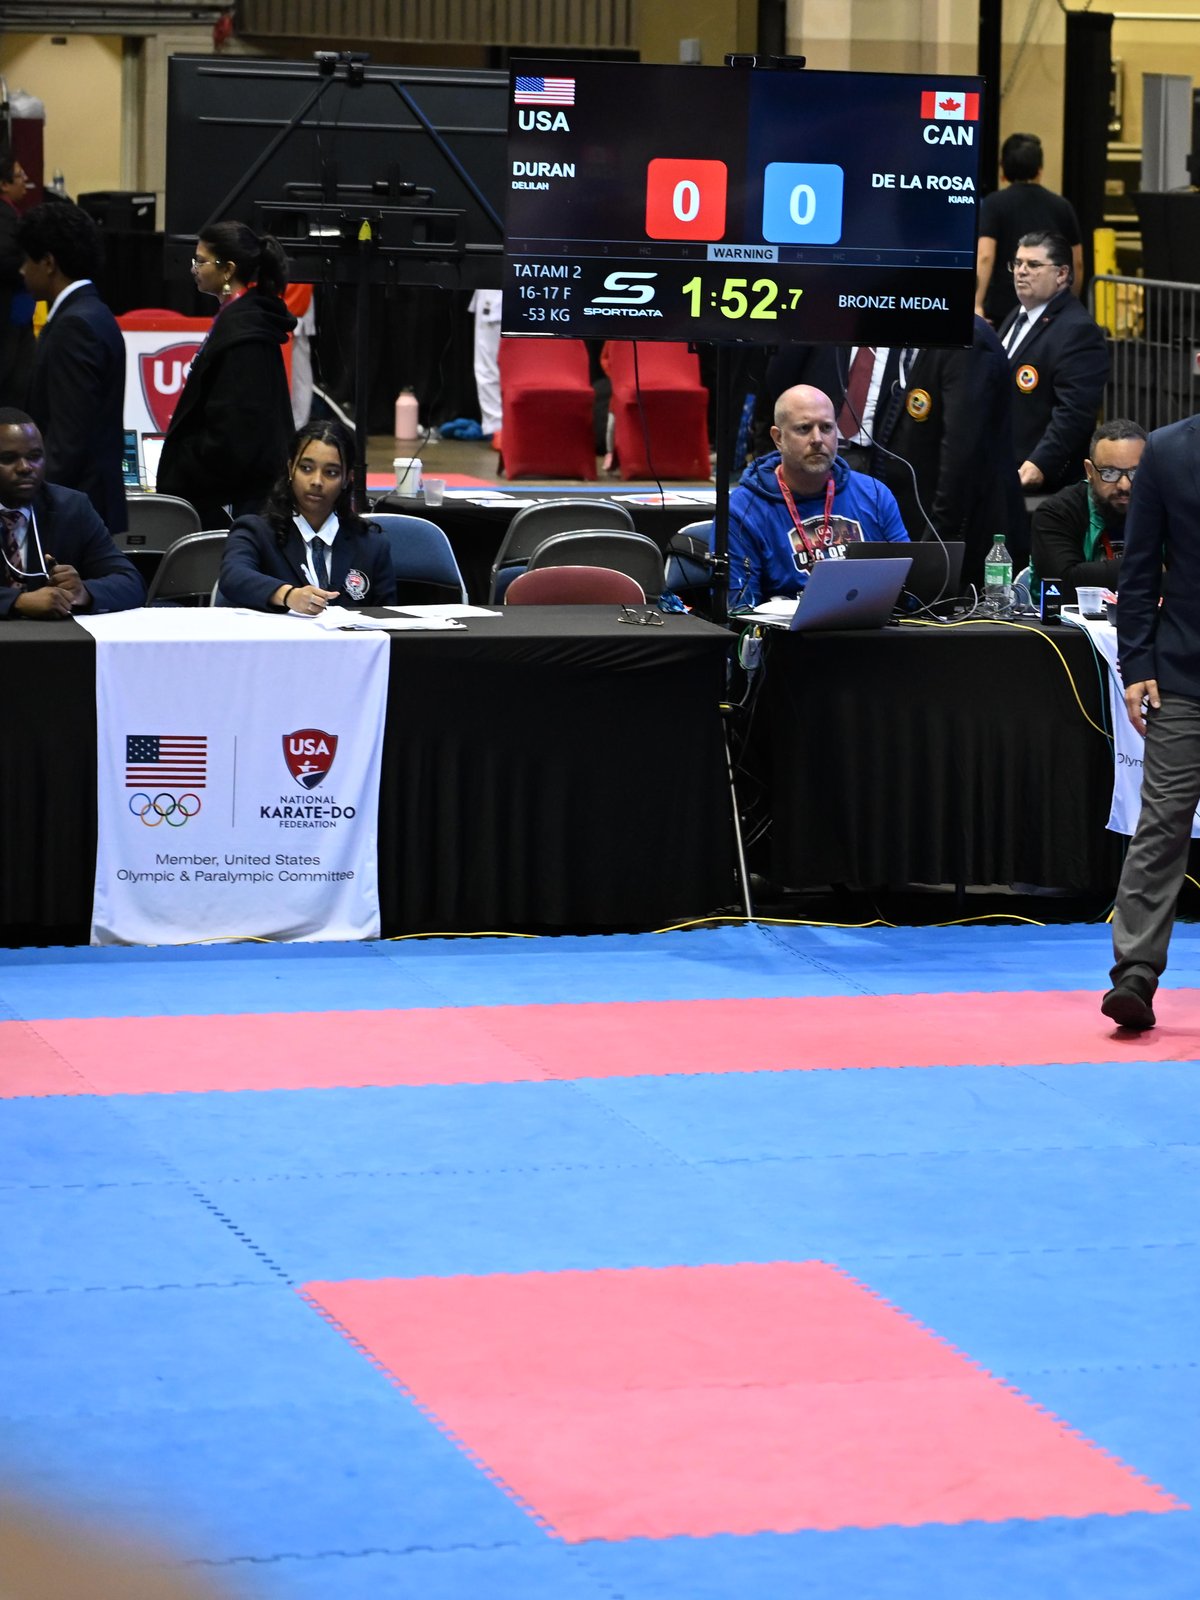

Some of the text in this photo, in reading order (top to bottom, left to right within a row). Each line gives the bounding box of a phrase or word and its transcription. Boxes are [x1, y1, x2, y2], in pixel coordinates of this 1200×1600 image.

[518, 110, 569, 132] USA
[923, 125, 974, 146] CAN
[512, 161, 576, 179] DURAN
[511, 181, 549, 191] DELILAH
[871, 174, 975, 192] DE LA ROSA
[672, 179, 701, 222] 0
[789, 184, 817, 225] 0
[948, 195, 975, 205] KIARA
[713, 247, 774, 261] WARNING
[513, 264, 582, 279] TATAMI 2
[519, 286, 572, 300] 16-17 F
[682, 277, 803, 321] 1:52.7
[838, 294, 950, 311] BRONZE MEDAL
[522, 308, 571, 322] -53 KG
[583, 307, 663, 318] SPORTDATA
[798, 543, 849, 565] UA OP
[289, 738, 330, 757] USA
[279, 795, 337, 805] NATIONAL
[260, 806, 356, 820] KARATE-DO
[279, 820, 337, 828] FEDERATION
[155, 853, 321, 867] Member, United States
[116, 869, 355, 883] Olympic & Paralympic Committee
